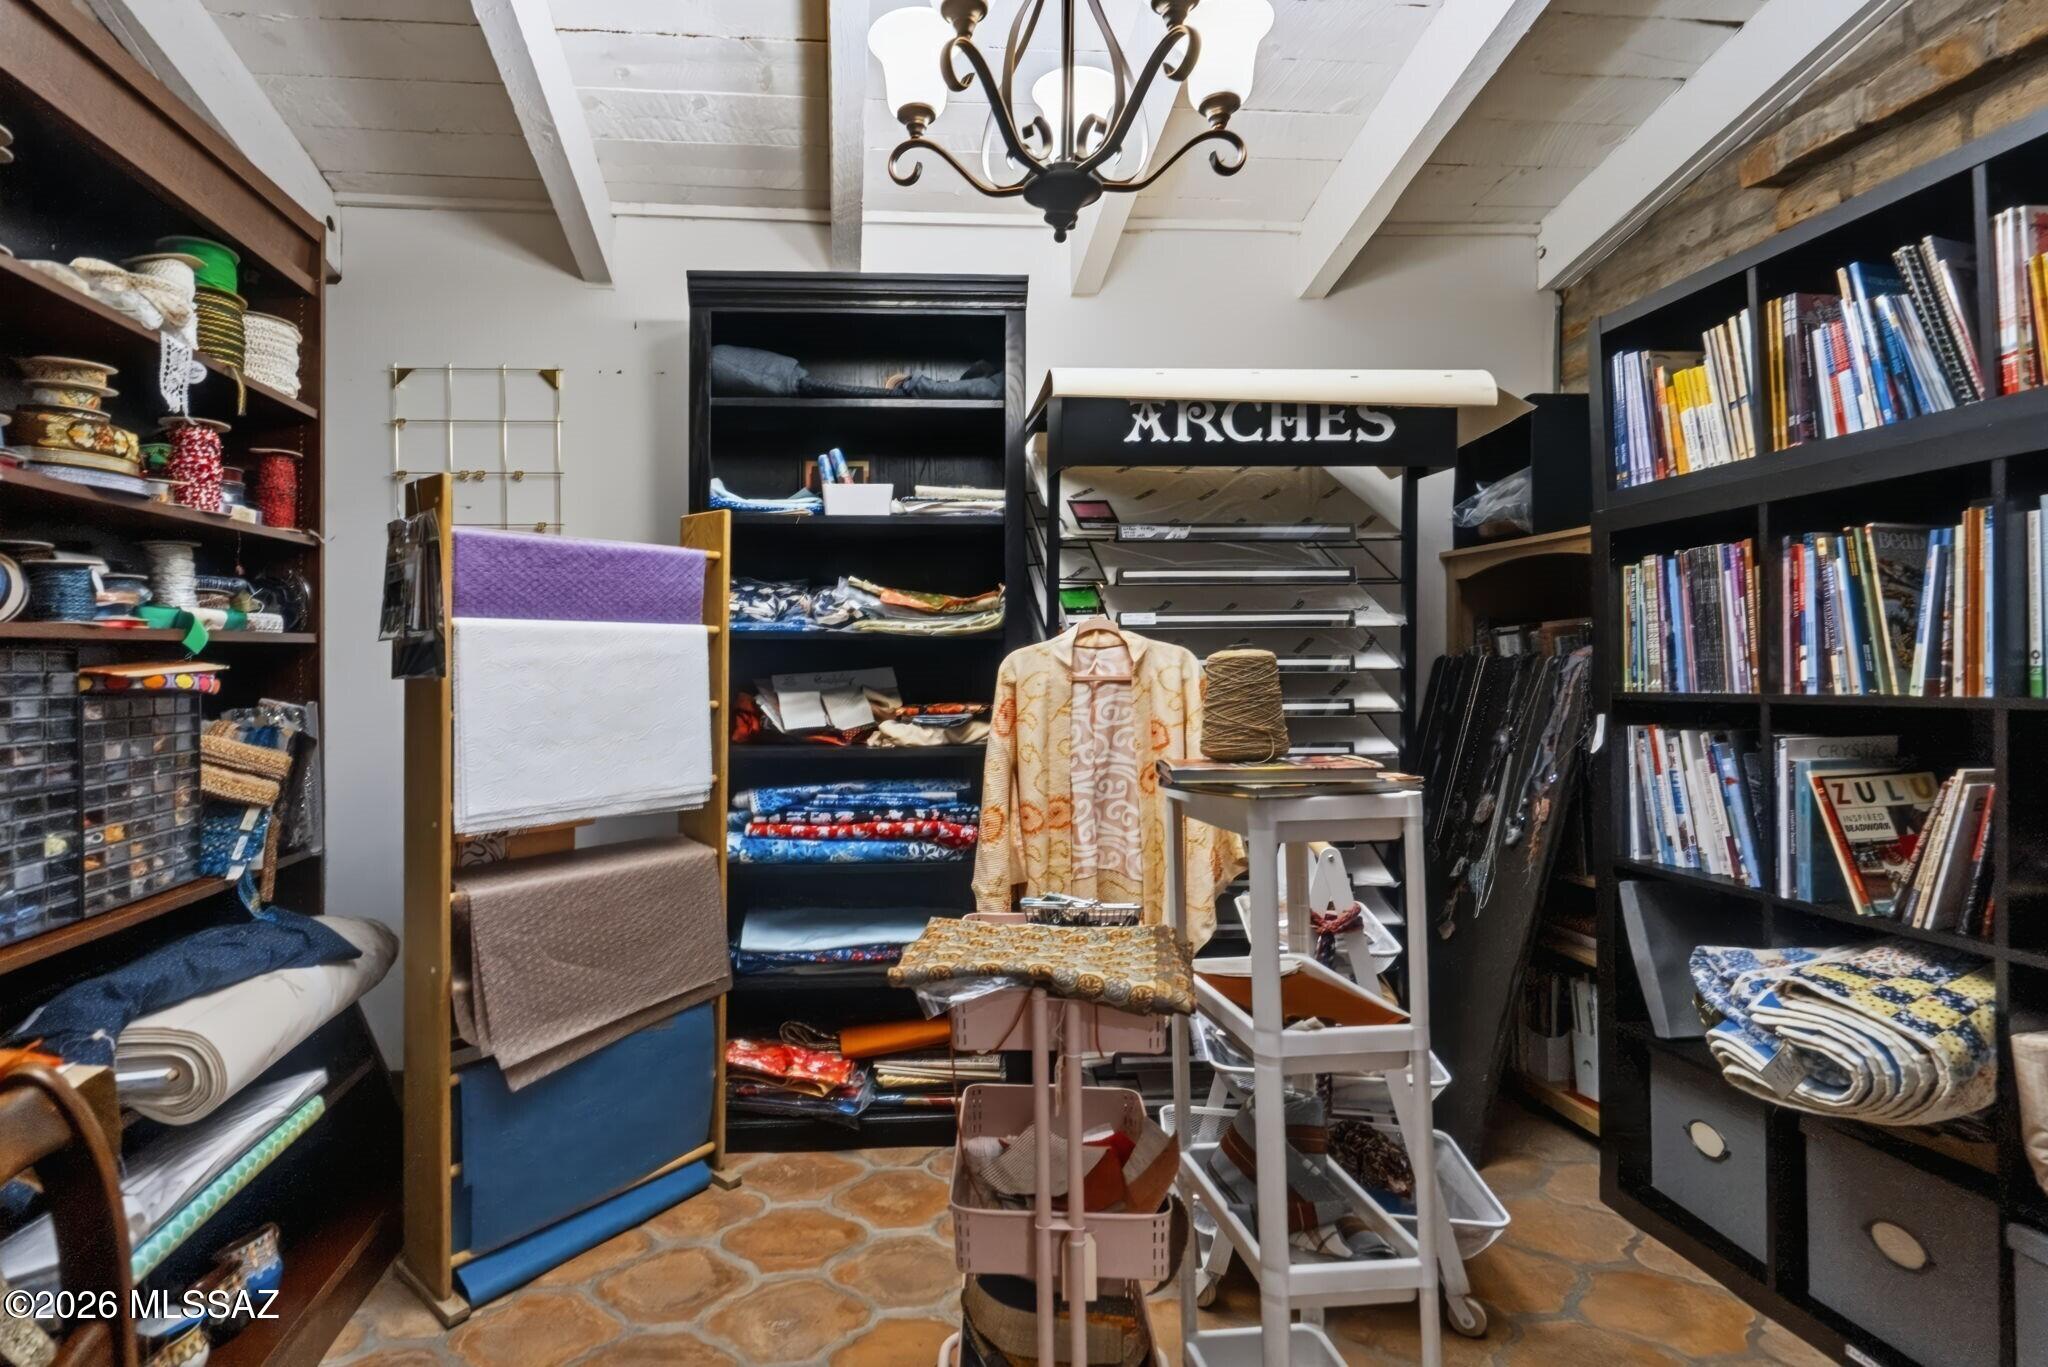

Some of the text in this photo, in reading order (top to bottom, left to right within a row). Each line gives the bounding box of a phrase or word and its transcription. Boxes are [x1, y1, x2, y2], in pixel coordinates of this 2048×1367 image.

[1123, 400, 1397, 443] ARCHES
[1817, 742, 1886, 759] CRYSTA
[1831, 775, 1933, 805] ZULU
[1843, 812, 1885, 822] INSPIRED
[1845, 822, 1891, 832] BEADWORK
